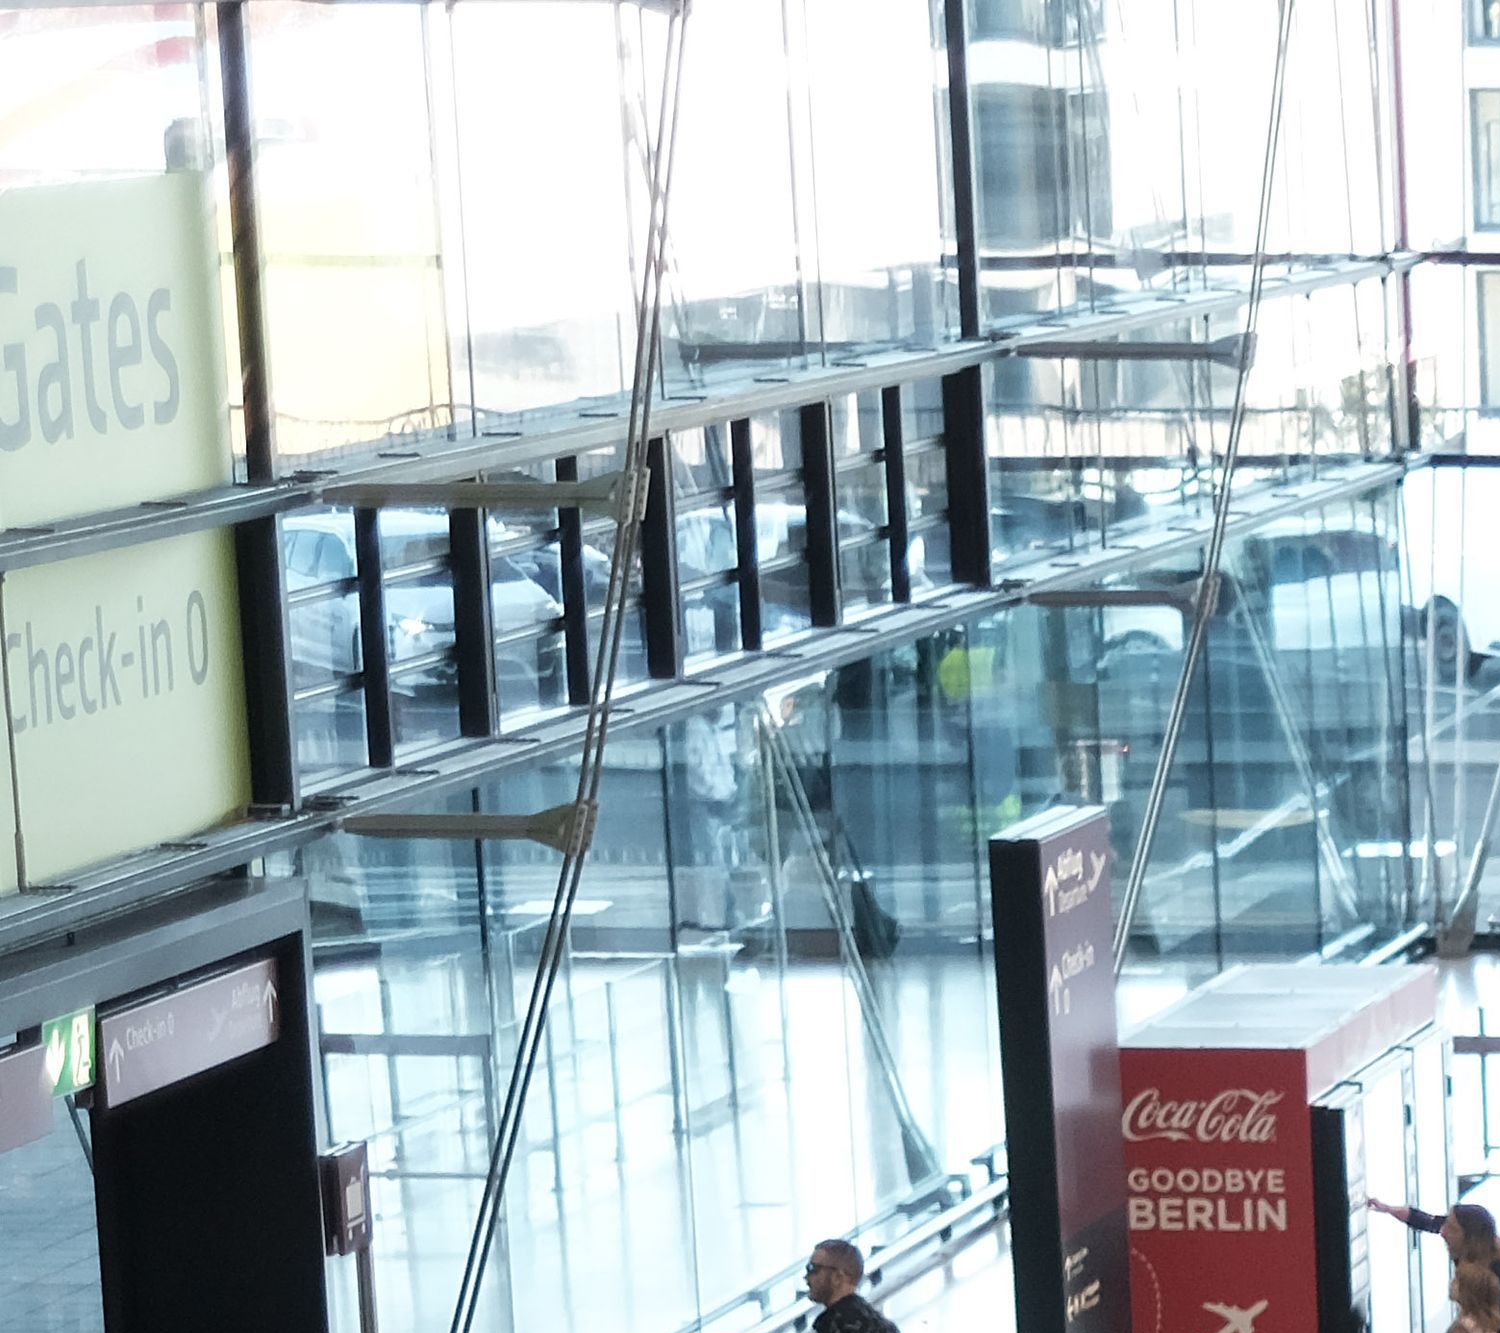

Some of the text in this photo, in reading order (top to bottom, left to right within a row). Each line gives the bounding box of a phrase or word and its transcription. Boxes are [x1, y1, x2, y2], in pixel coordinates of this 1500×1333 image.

[1122, 1089, 1283, 1142] Coca-Cola
[1127, 1168, 1285, 1193] GOODBYE
[1128, 1198, 1287, 1231] BERLIN
